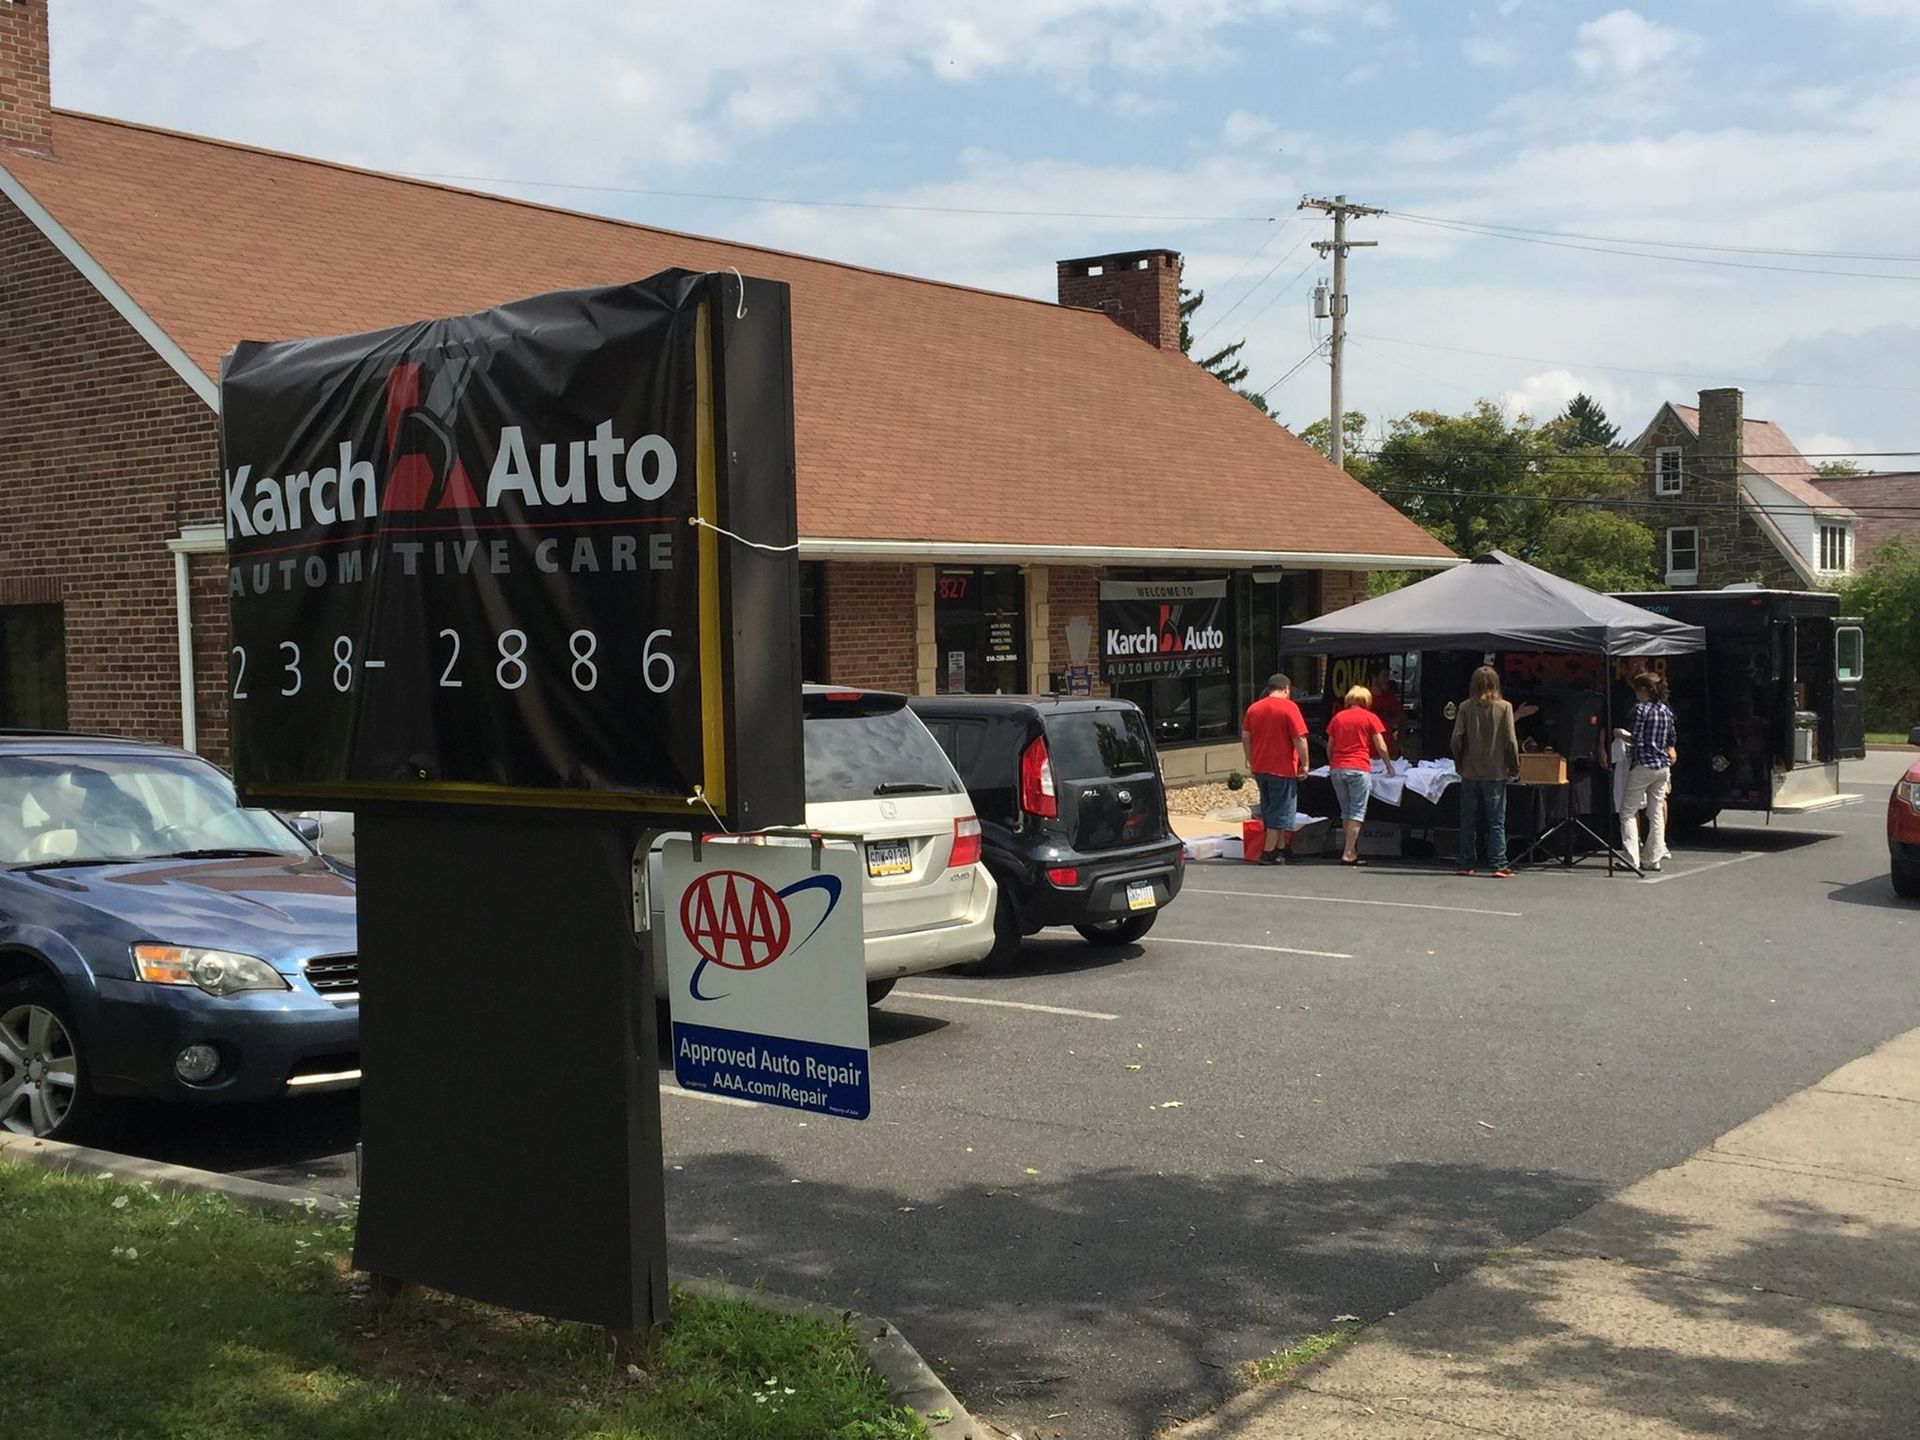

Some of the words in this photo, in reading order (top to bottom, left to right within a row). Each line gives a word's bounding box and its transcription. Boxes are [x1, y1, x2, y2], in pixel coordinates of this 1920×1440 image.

[226, 441, 377, 539] Karch
[486, 417, 678, 508] Auto
[229, 539, 511, 598] AUTOMTIVE
[534, 533, 675, 573] CARE
[940, 577, 968, 598] 827
[1137, 587, 1180, 597] WELCOME
[1183, 586, 1194, 597] TO
[439, 628, 676, 694] 2886
[1107, 626, 1158, 655] Karch
[1184, 626, 1223, 651] Auto
[1107, 659, 1192, 676] AUTOMOTIVE
[1196, 656, 1224, 669] CARE
[686, 871, 786, 968] AAA
[680, 1037, 756, 1069] Approved
[760, 1049, 801, 1076] Auto
[806, 1056, 862, 1088] Repair
[713, 1071, 828, 1107] AAA.com/Repair
